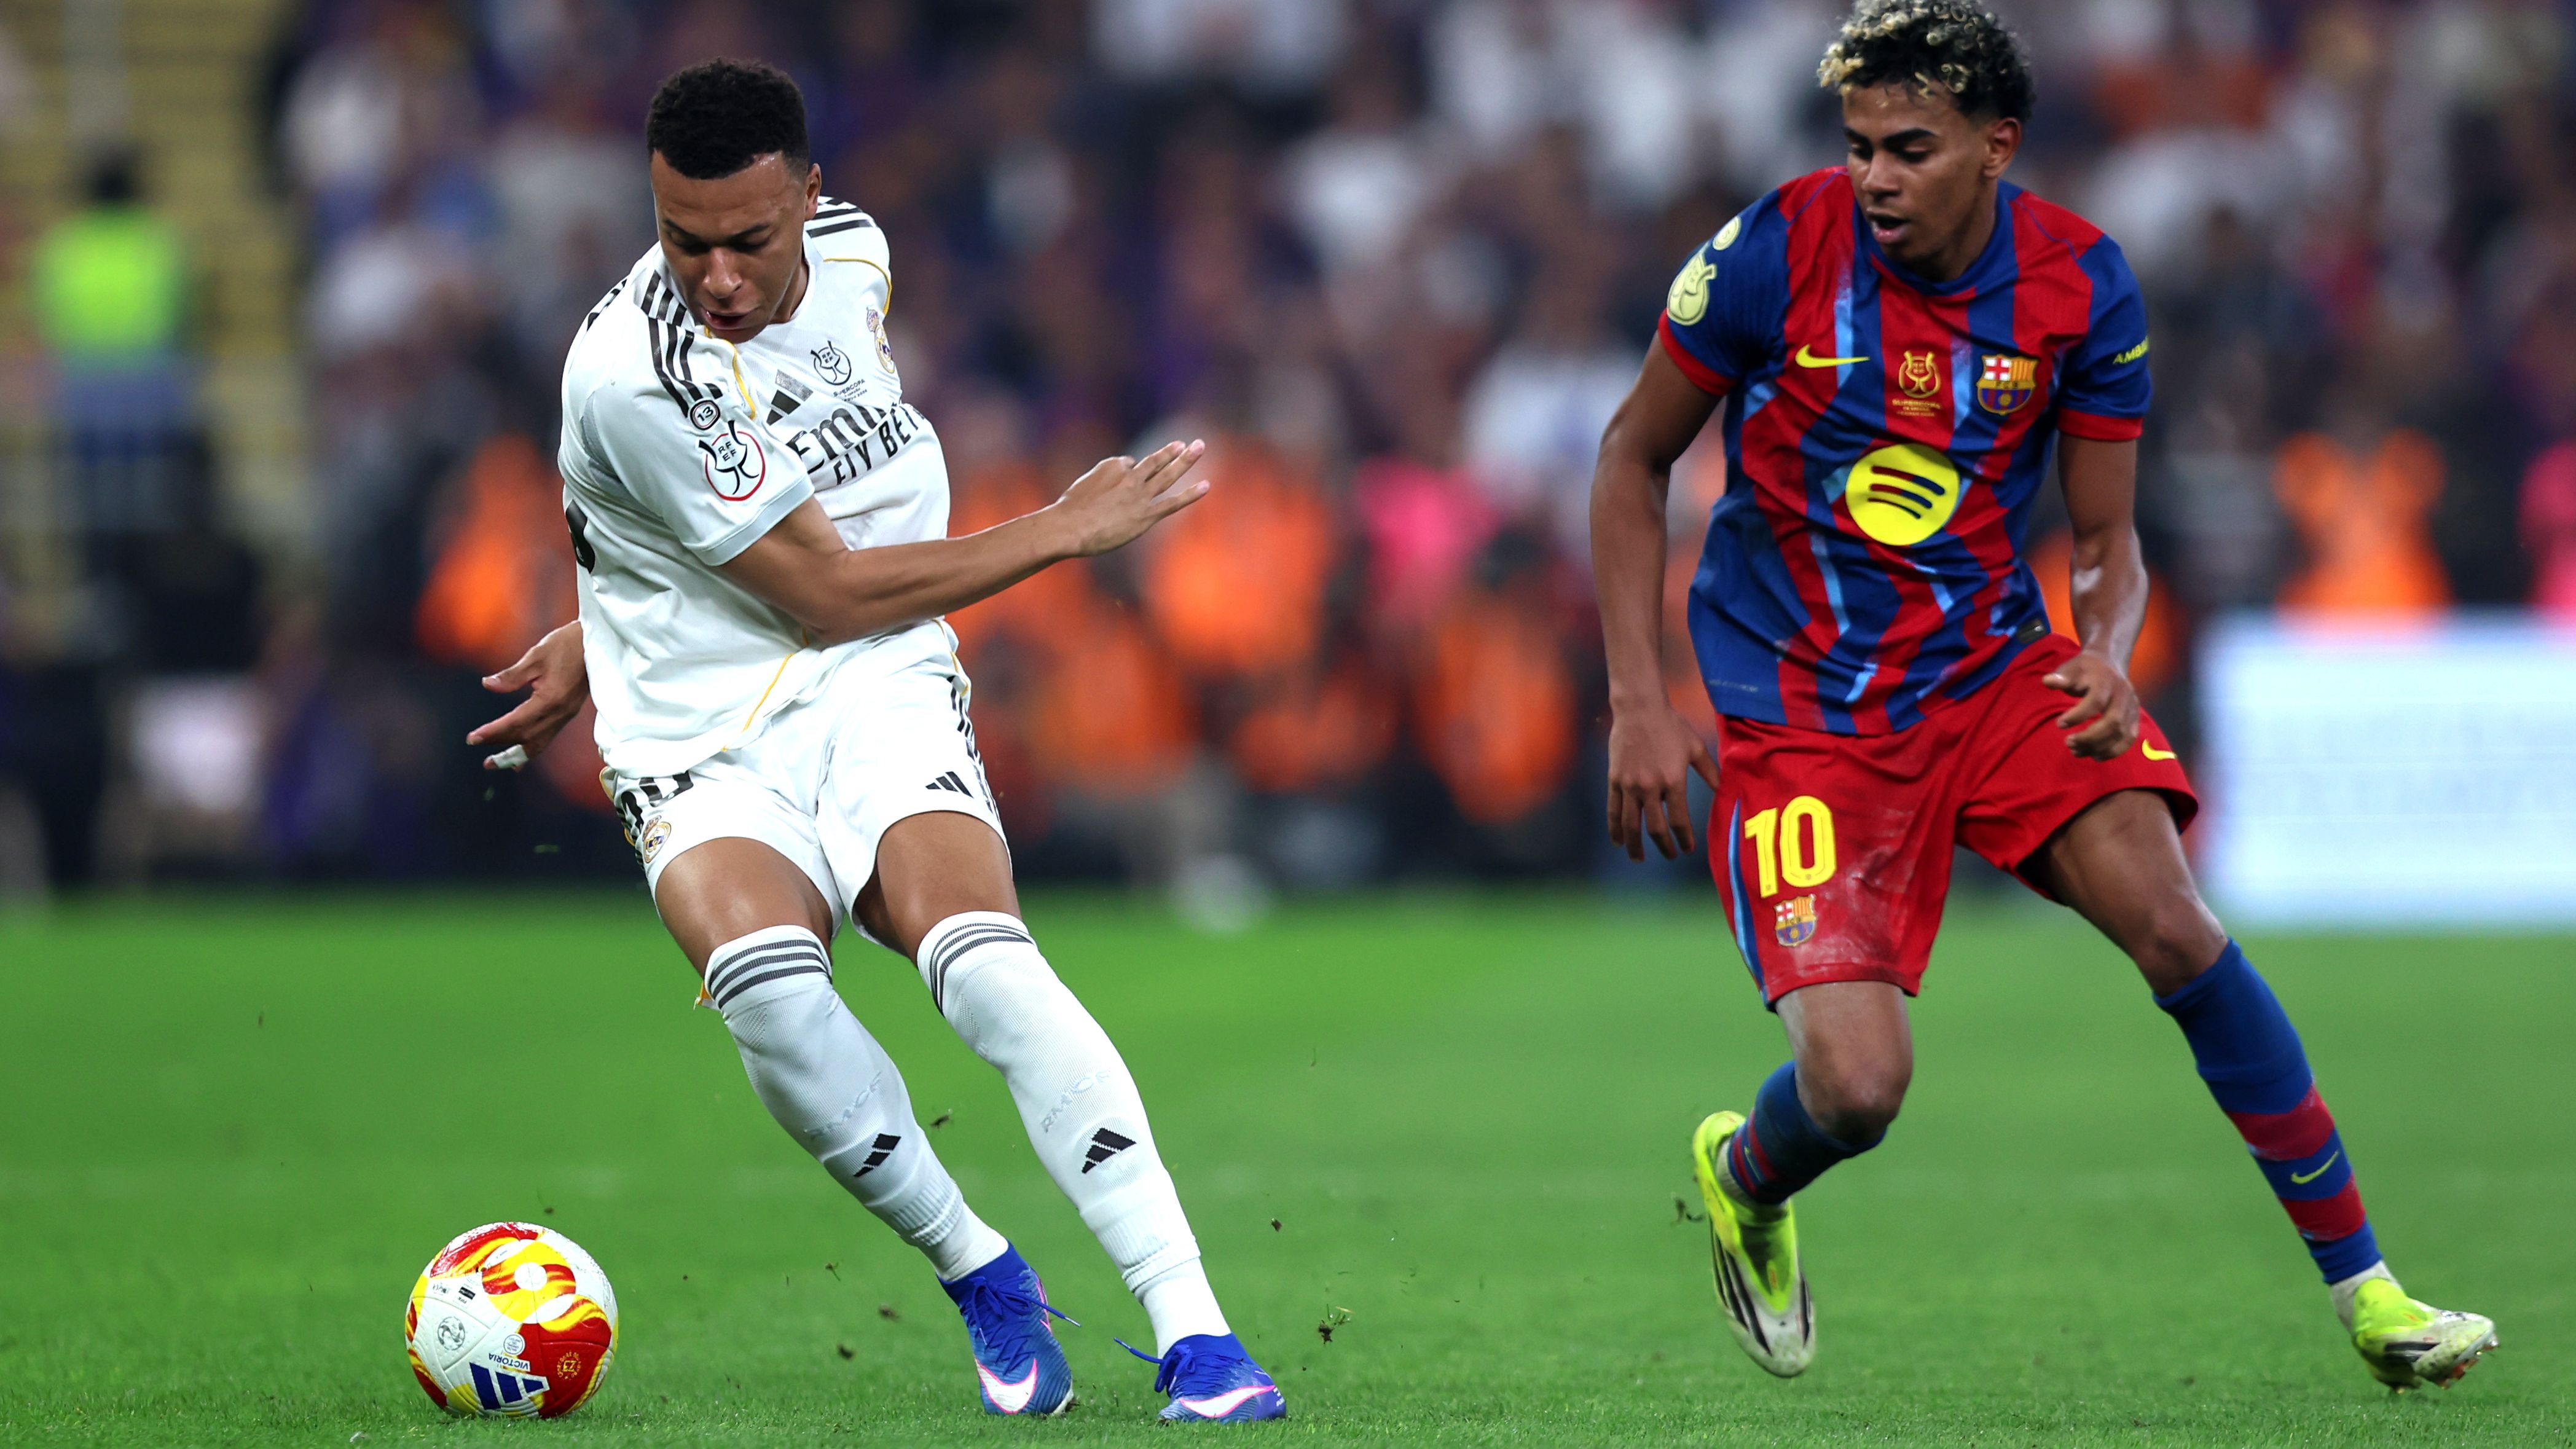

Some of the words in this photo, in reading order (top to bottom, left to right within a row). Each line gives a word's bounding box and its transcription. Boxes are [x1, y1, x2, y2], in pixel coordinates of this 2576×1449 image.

[697, 406, 714, 422] 13
[718, 441, 732, 454] RF
[722, 449, 737, 461] EF
[1745, 795, 1837, 898] 10
[489, 1353, 529, 1370] VICTORIA
